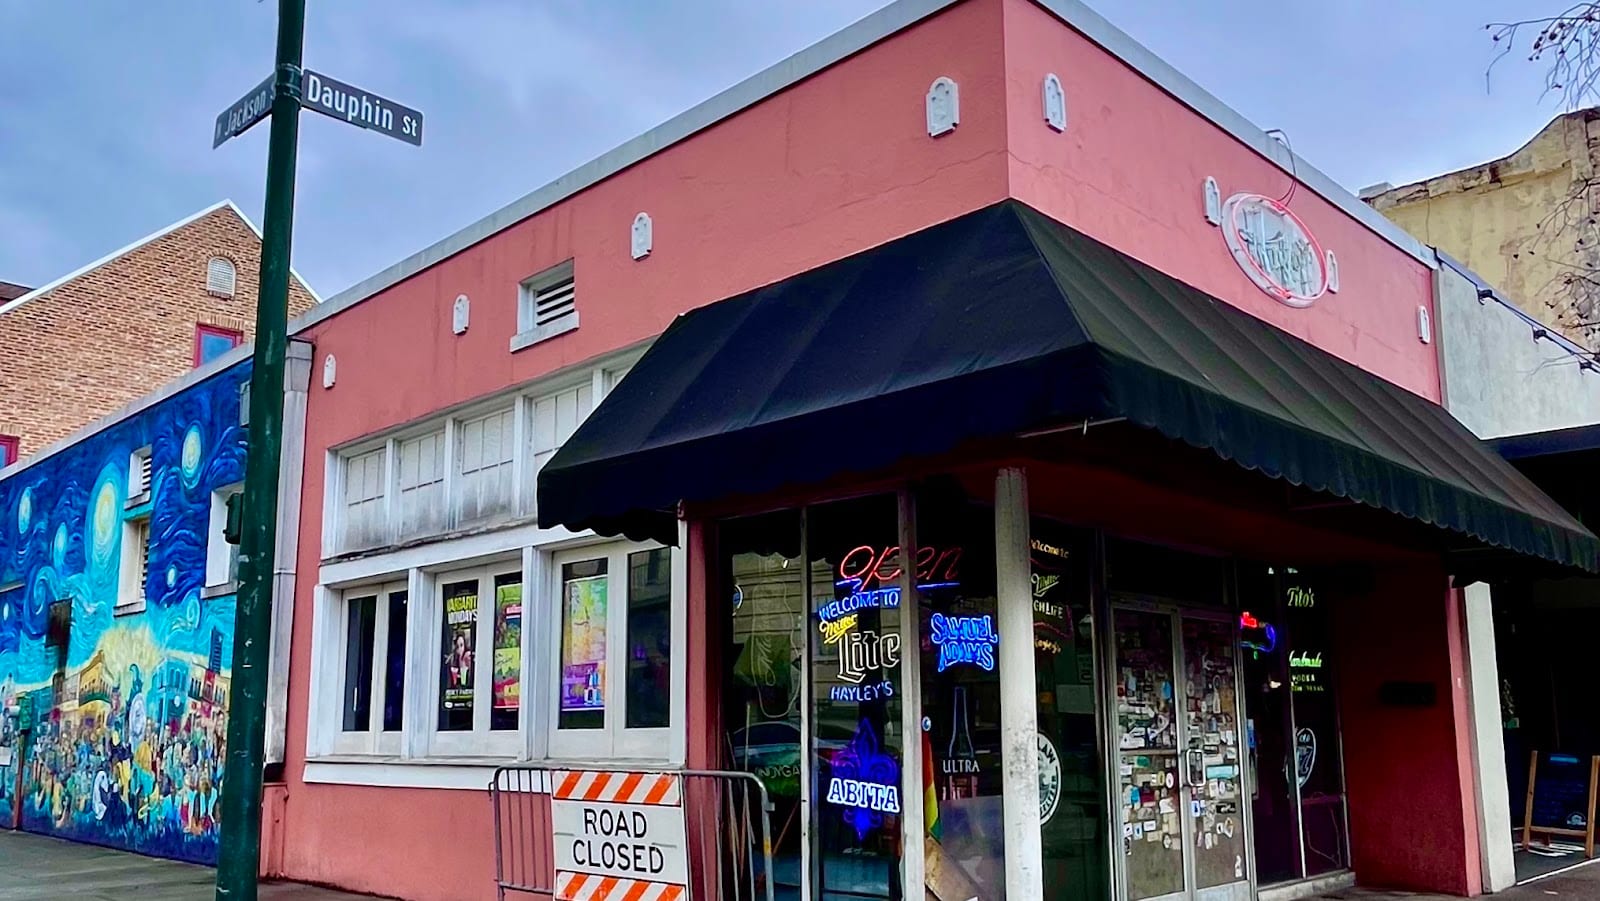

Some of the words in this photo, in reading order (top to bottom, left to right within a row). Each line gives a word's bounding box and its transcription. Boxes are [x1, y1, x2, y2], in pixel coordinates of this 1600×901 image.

[225, 90, 266, 136] Jackson
[308, 75, 393, 130] Dauphin
[403, 115, 417, 137] St
[819, 592, 879, 620] WELCOME
[882, 591, 899, 606] TO
[1287, 586, 1315, 607] Tito's
[819, 613, 859, 644] Miller
[931, 613, 998, 644] SAMUEL
[837, 630, 900, 684] Lite
[938, 641, 994, 672] ADAMS
[831, 681, 894, 701] HAYLEY'S
[1292, 673, 1316, 682] VODKA
[942, 759, 980, 773] ULTRA
[828, 778, 900, 813] ABITA
[583, 808, 647, 839] ROAD
[572, 839, 664, 874] CLOSED
